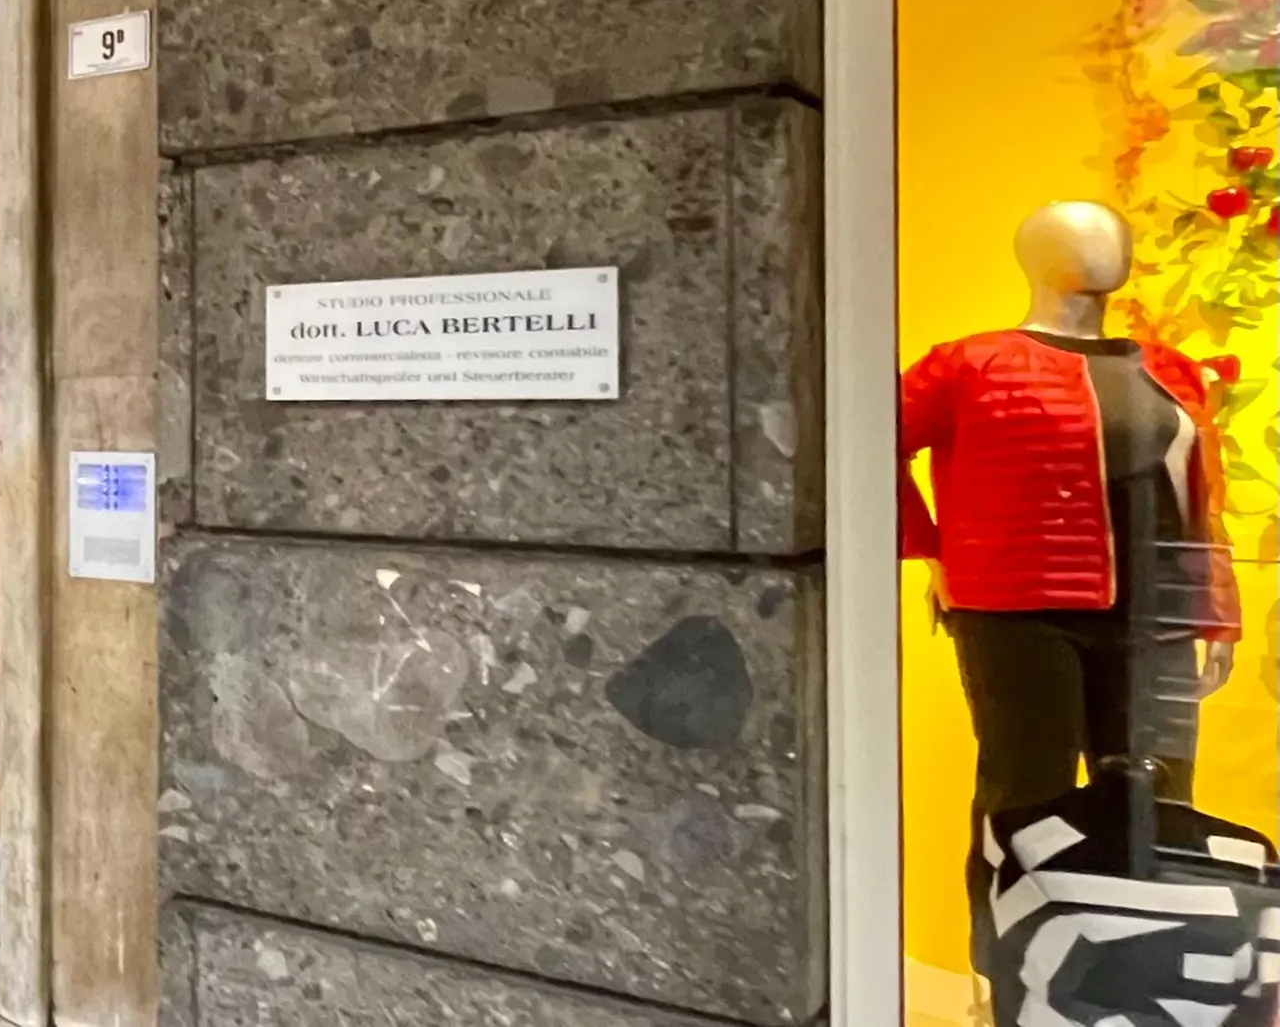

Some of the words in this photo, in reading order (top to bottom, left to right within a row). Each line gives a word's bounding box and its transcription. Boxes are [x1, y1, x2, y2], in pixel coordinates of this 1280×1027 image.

[317, 296, 383, 310] STUDIO
[390, 288, 552, 308] PROFESSIONALE
[290, 322, 346, 340] dott.
[356, 319, 431, 338] LUCA
[441, 312, 597, 335] BERTELLI
[528, 344, 609, 360] contabile
